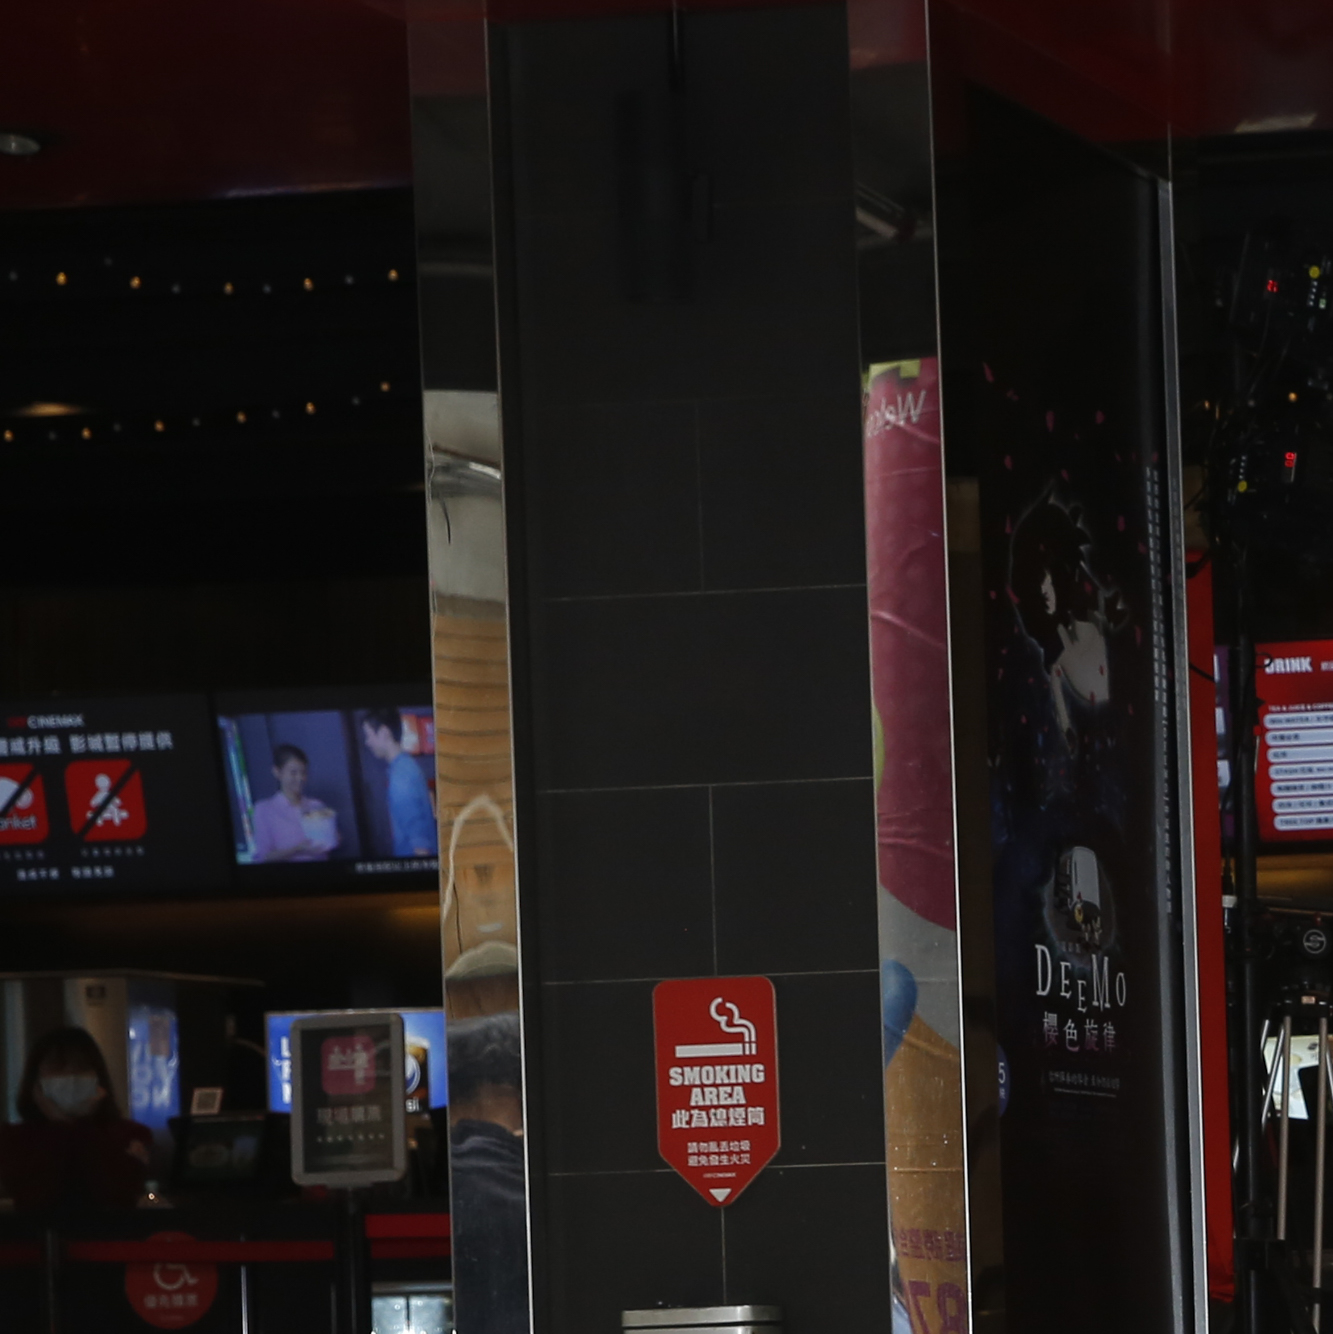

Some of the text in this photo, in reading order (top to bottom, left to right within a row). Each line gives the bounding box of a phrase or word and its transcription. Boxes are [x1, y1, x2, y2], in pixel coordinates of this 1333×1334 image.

[1264, 656, 1313, 674] DRINK
[1035, 944, 1126, 1013] DEEMO
[669, 1064, 765, 1086] SMOKING
[690, 1085, 747, 1106] AREA
